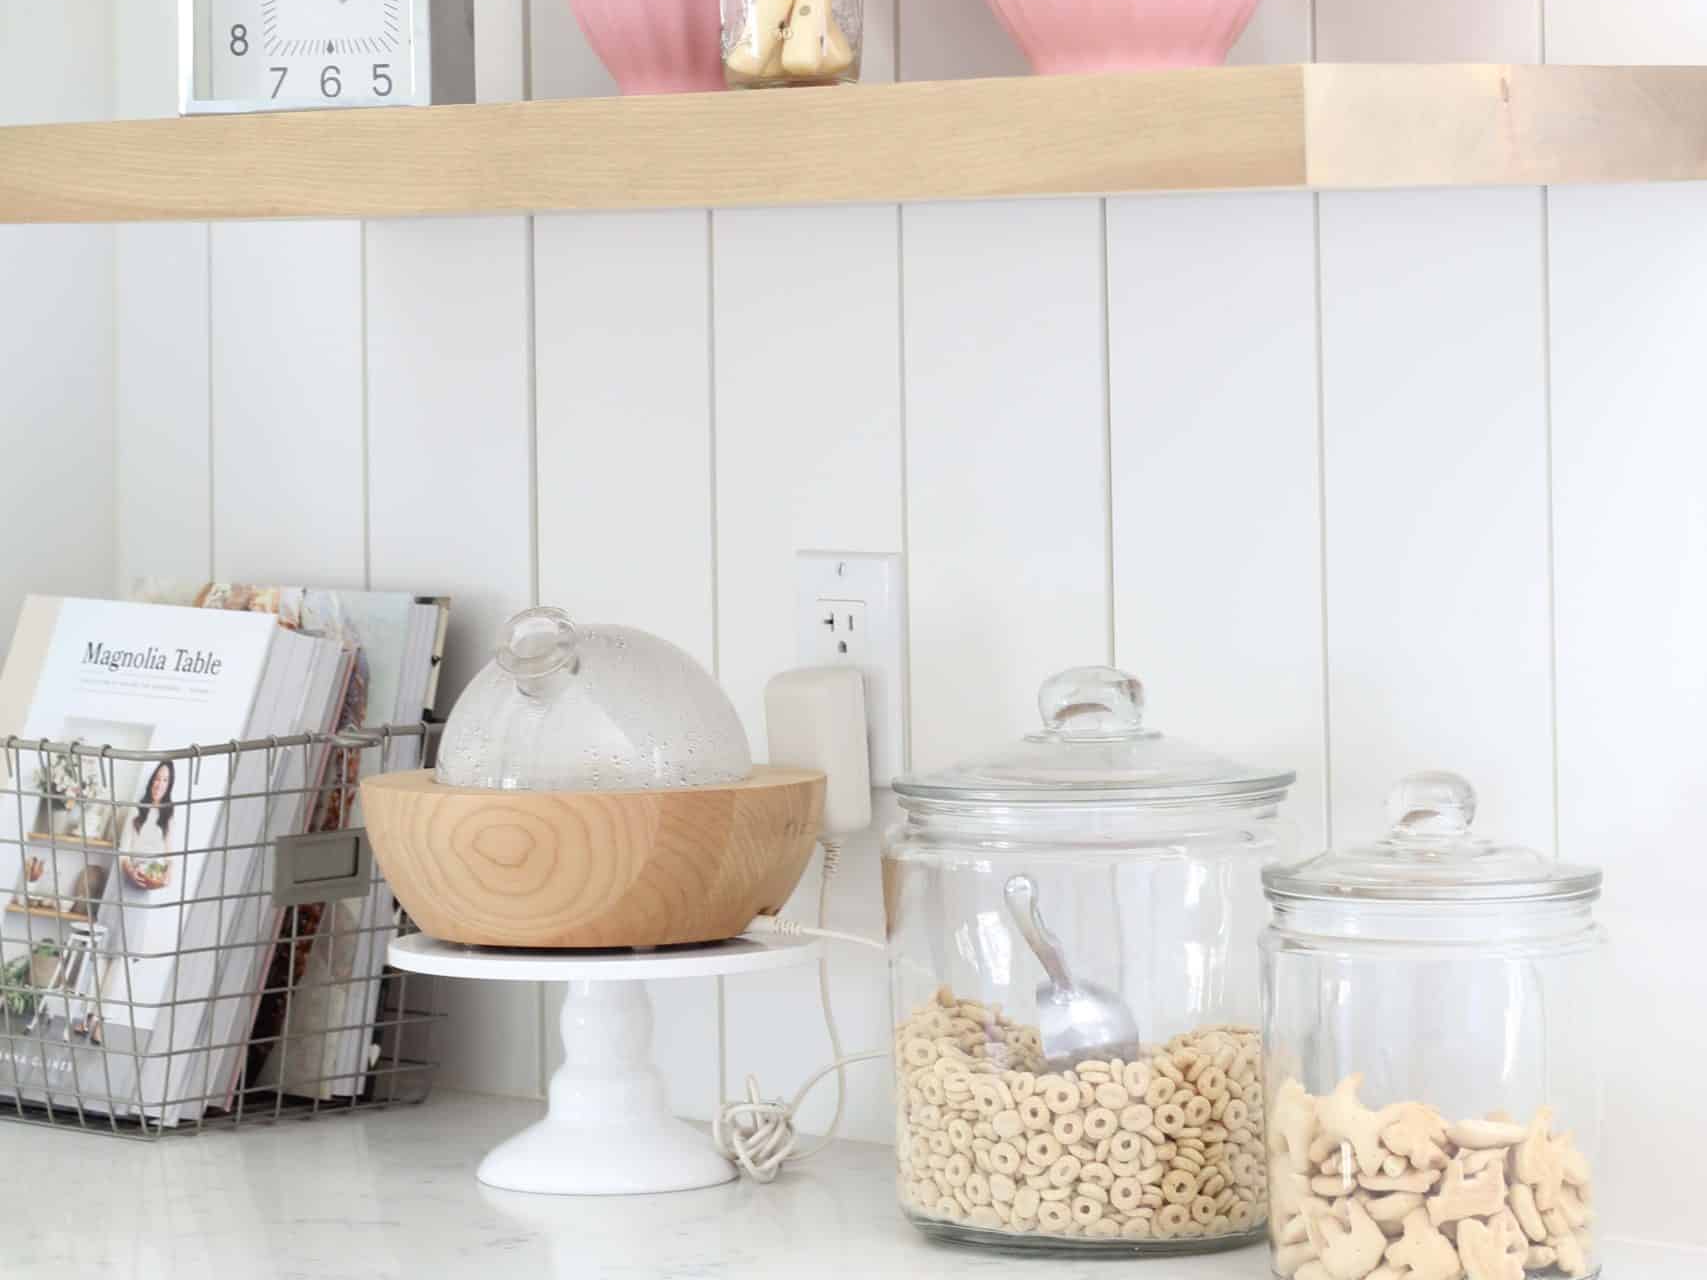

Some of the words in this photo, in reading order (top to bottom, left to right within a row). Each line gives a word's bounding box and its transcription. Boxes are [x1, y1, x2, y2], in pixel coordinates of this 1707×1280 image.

[229, 22, 250, 57] 8
[269, 66, 289, 100] 7
[320, 64, 342, 98] 6
[371, 63, 394, 97] 5
[81, 641, 168, 673] Magnolia
[174, 648, 223, 676] Table
